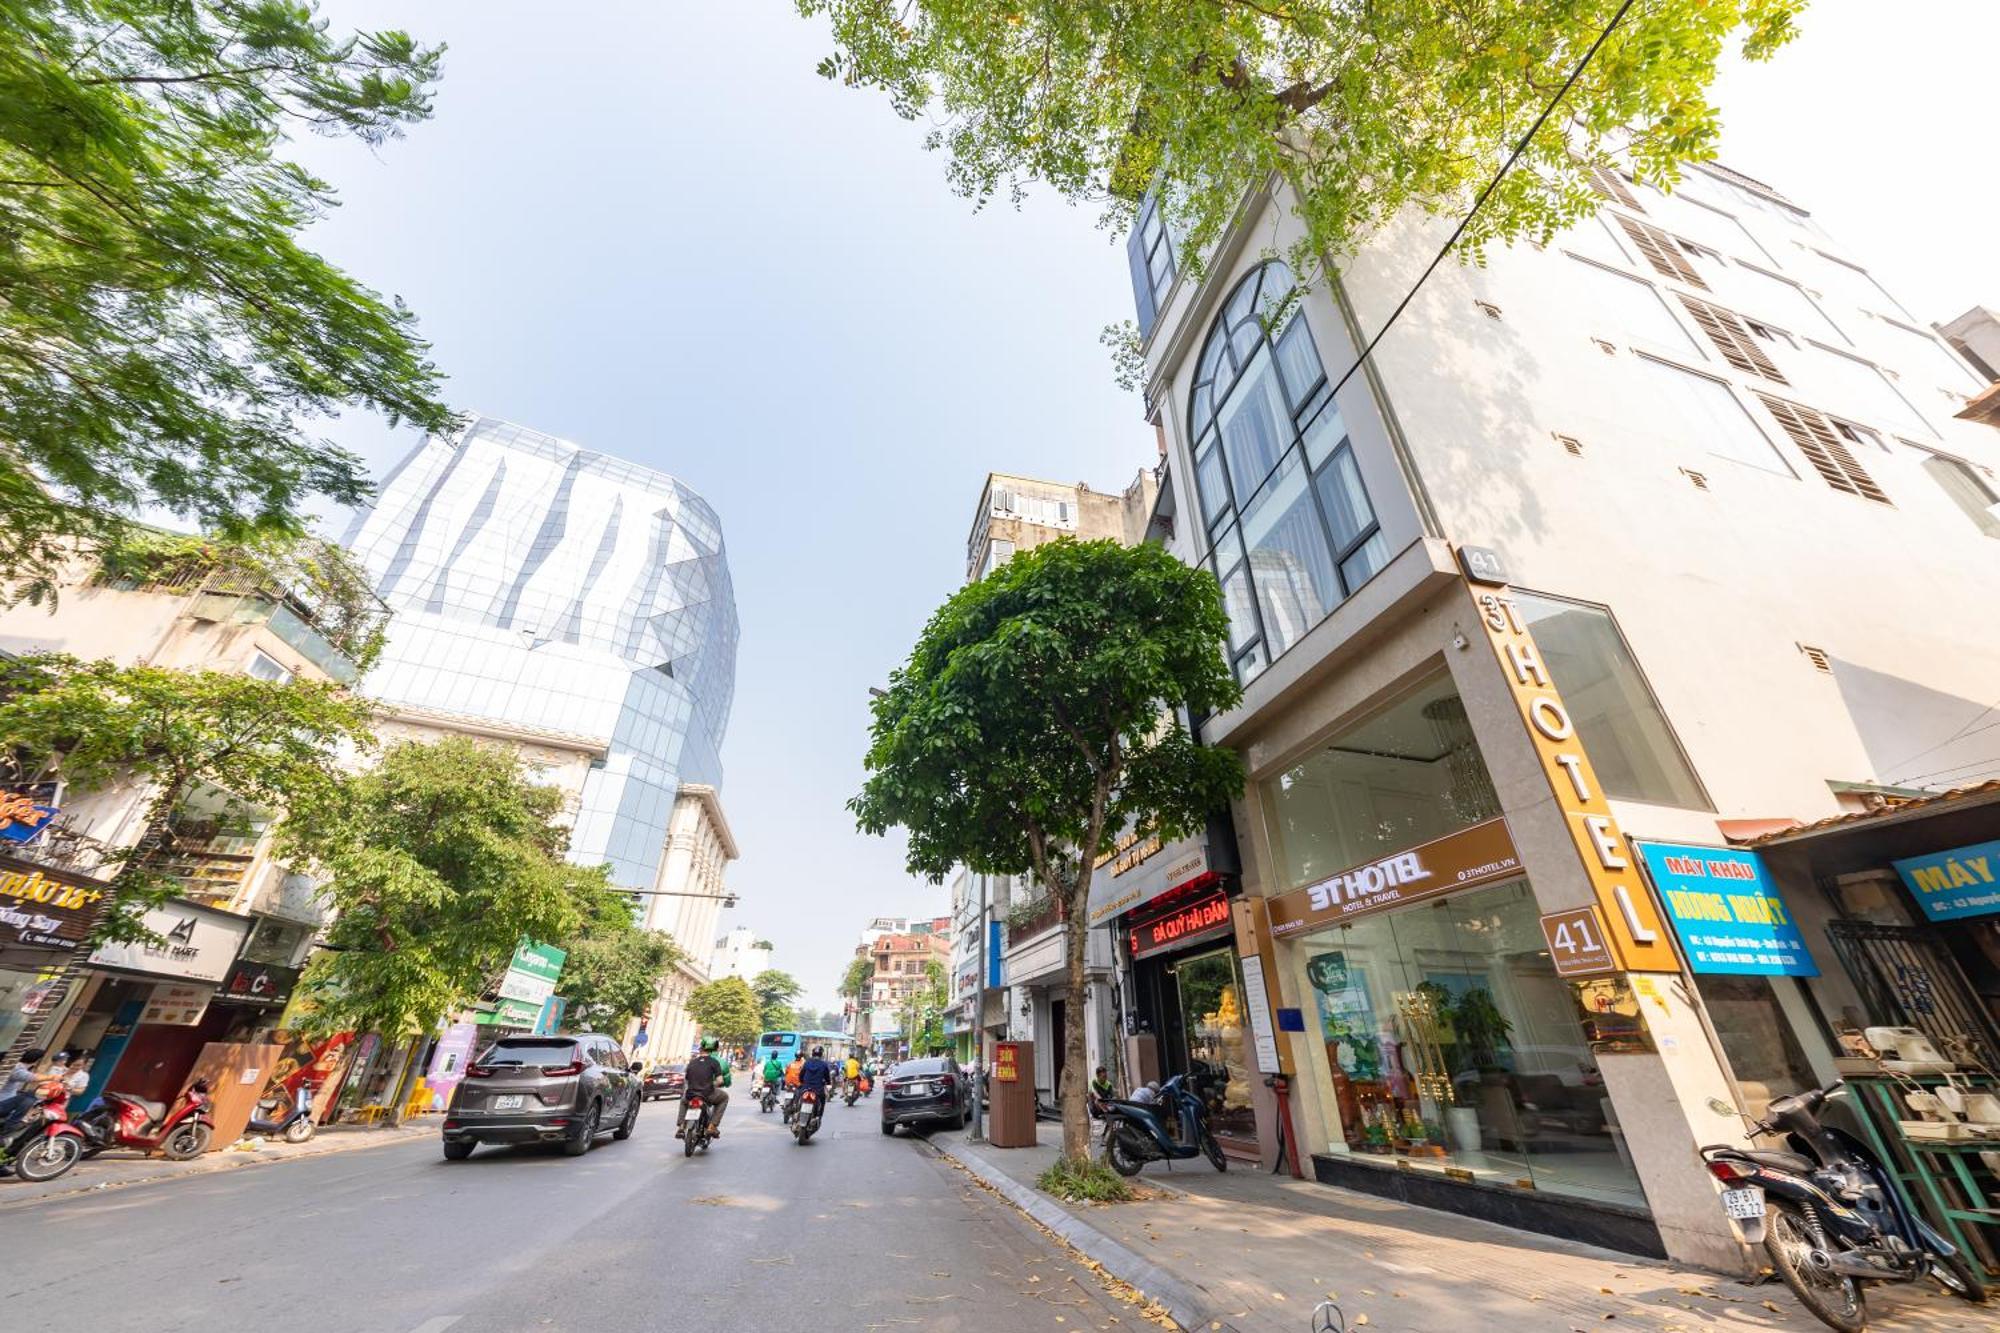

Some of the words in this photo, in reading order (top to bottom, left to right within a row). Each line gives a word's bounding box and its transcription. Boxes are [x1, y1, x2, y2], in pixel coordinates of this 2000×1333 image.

[1471, 552, 1500, 573] 41
[1343, 852, 1432, 899] HOTEL
[1706, 859, 1756, 880] KHÂU
[1911, 857, 1995, 893] MÁY
[1342, 901, 1364, 913] HOTEL
[1373, 890, 1400, 903] TRAVEL
[1153, 922, 1167, 943] ĐÁ
[1554, 919, 1601, 954] 41
